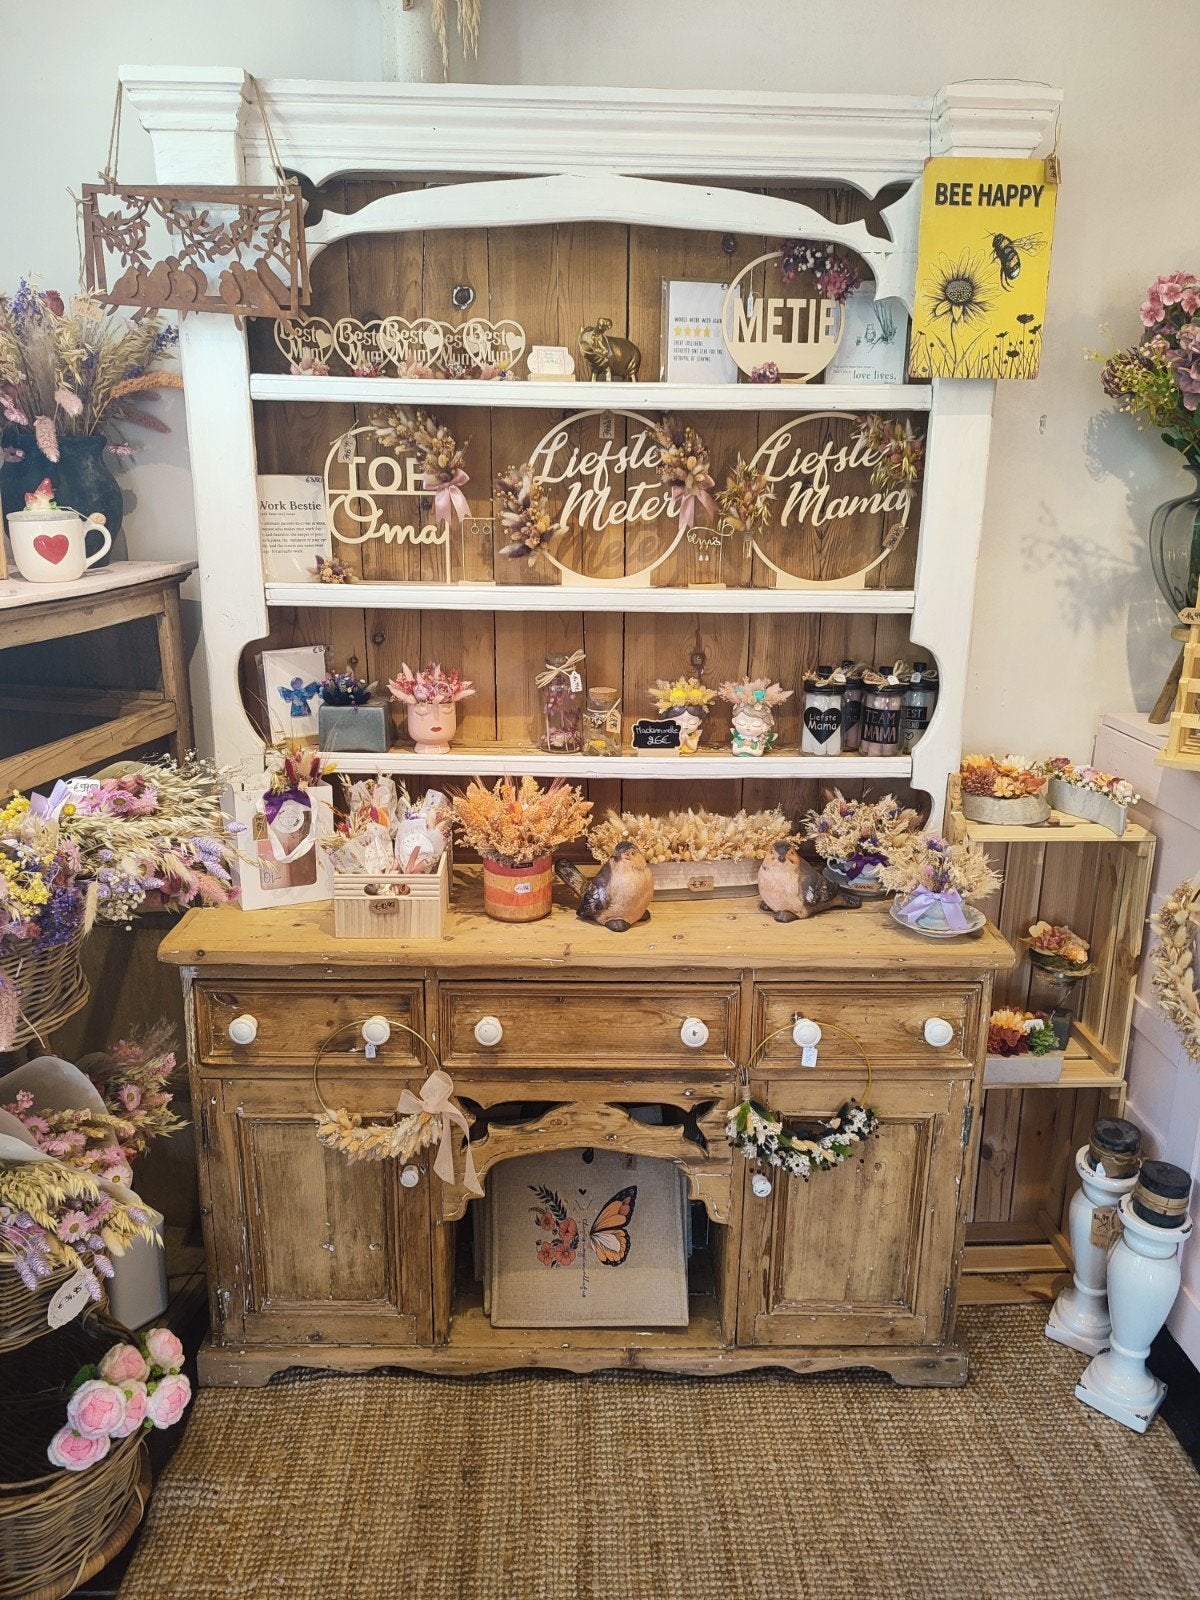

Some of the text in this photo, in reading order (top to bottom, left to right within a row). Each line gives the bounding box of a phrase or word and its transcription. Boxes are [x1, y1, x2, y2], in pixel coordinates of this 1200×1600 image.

[935, 182, 1044, 207] BEE HAPPY
[732, 298, 837, 343] METIE
[339, 323, 377, 345] Best
[386, 321, 424, 344] Best
[467, 323, 507, 346] Best
[476, 342, 513, 366] Mum
[853, 370, 872, 380] love
[533, 431, 663, 494] Liefste
[763, 432, 889, 492] Liefste
[290, 500, 322, 511] Bestie
[556, 481, 681, 533] Meter
[781, 481, 908, 527] Mama
[329, 493, 447, 545] Oma
[808, 720, 837, 731] Mama
[809, 713, 837, 721] Liefste
[865, 709, 896, 725] TEAM
[906, 709, 922, 719] EST
[864, 724, 897, 742] MAMA
